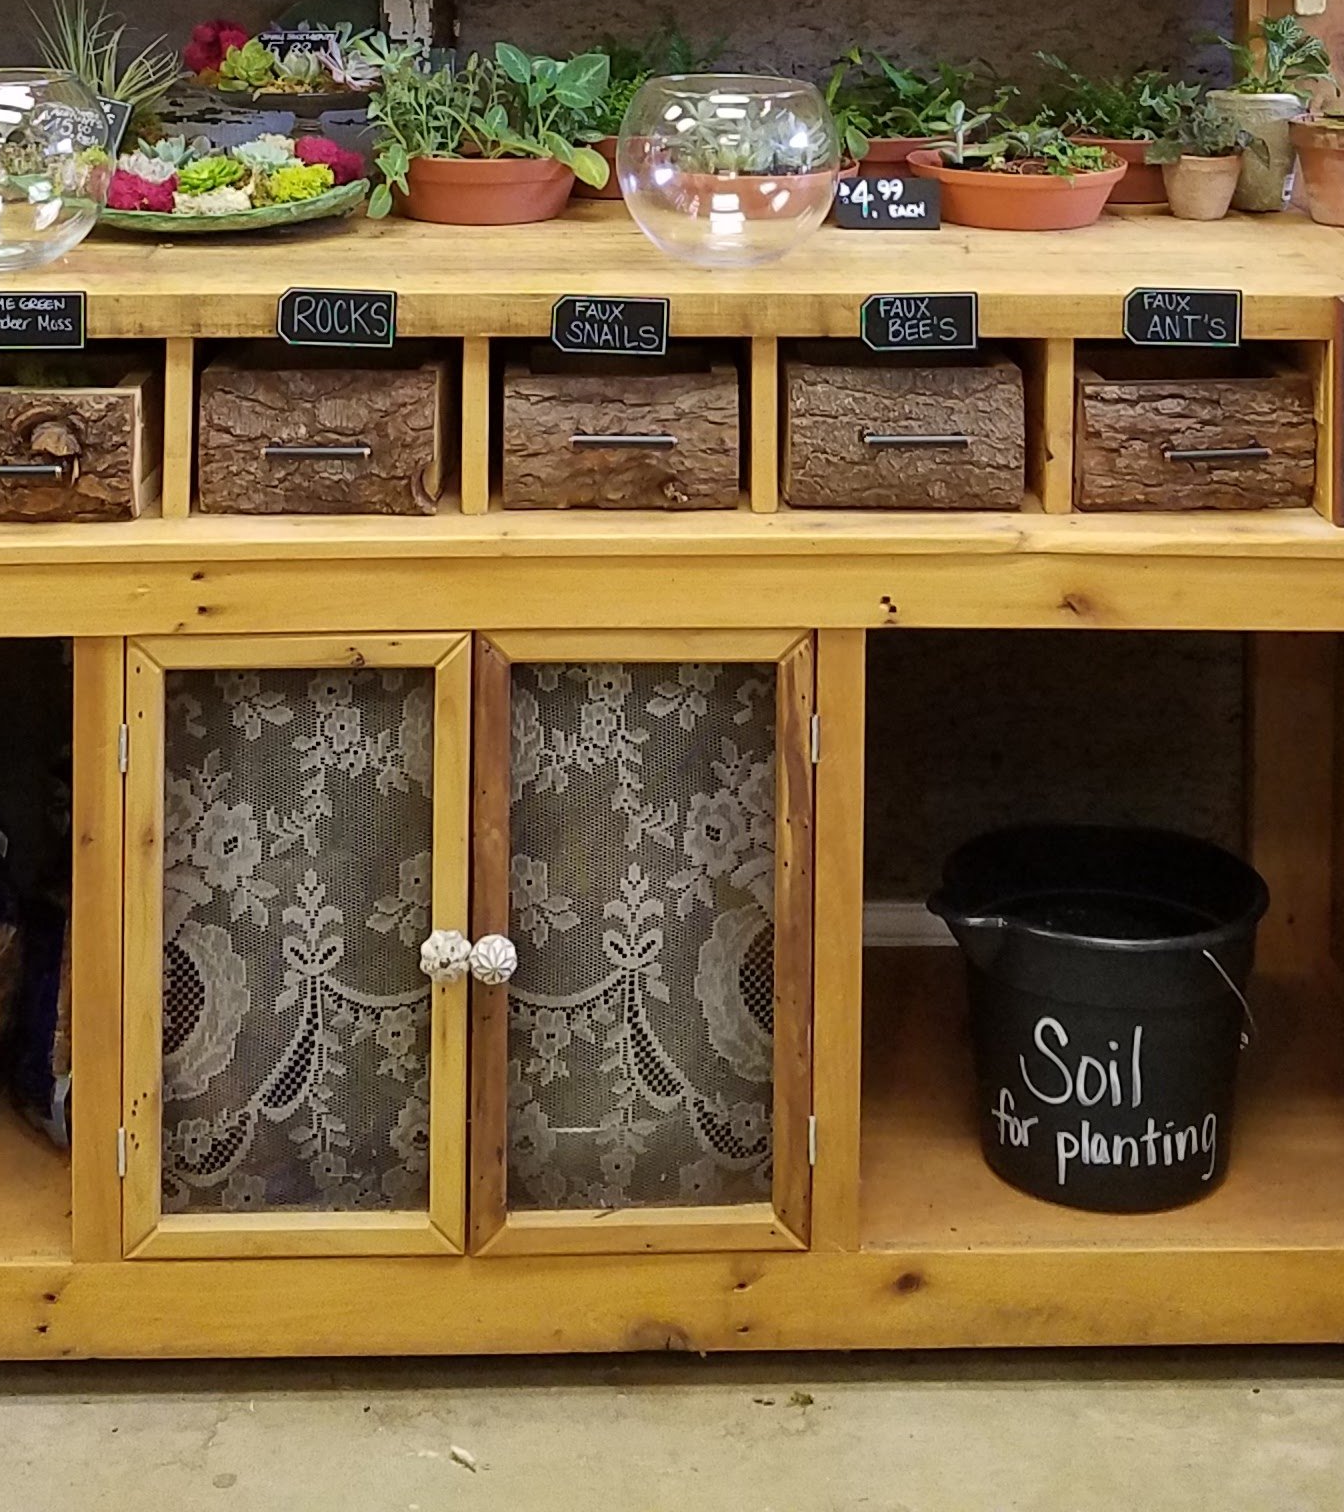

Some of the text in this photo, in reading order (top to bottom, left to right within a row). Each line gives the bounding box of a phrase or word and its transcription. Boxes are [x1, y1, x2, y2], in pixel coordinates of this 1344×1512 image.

[18, 297, 66, 311] GREEN
[575, 301, 625, 321] FAUX
[879, 297, 931, 318] FAUX
[1143, 293, 1190, 311] FAUX
[37, 314, 73, 331] Moss
[293, 296, 388, 337] ROCKS
[1147, 314, 1227, 340] ANT'S
[566, 321, 660, 349] SNAILS
[888, 318, 958, 342] BEE'S
[1019, 1016, 1143, 1108] Soil
[991, 1088, 1038, 1147] for
[1057, 1112, 1216, 1185] planting
